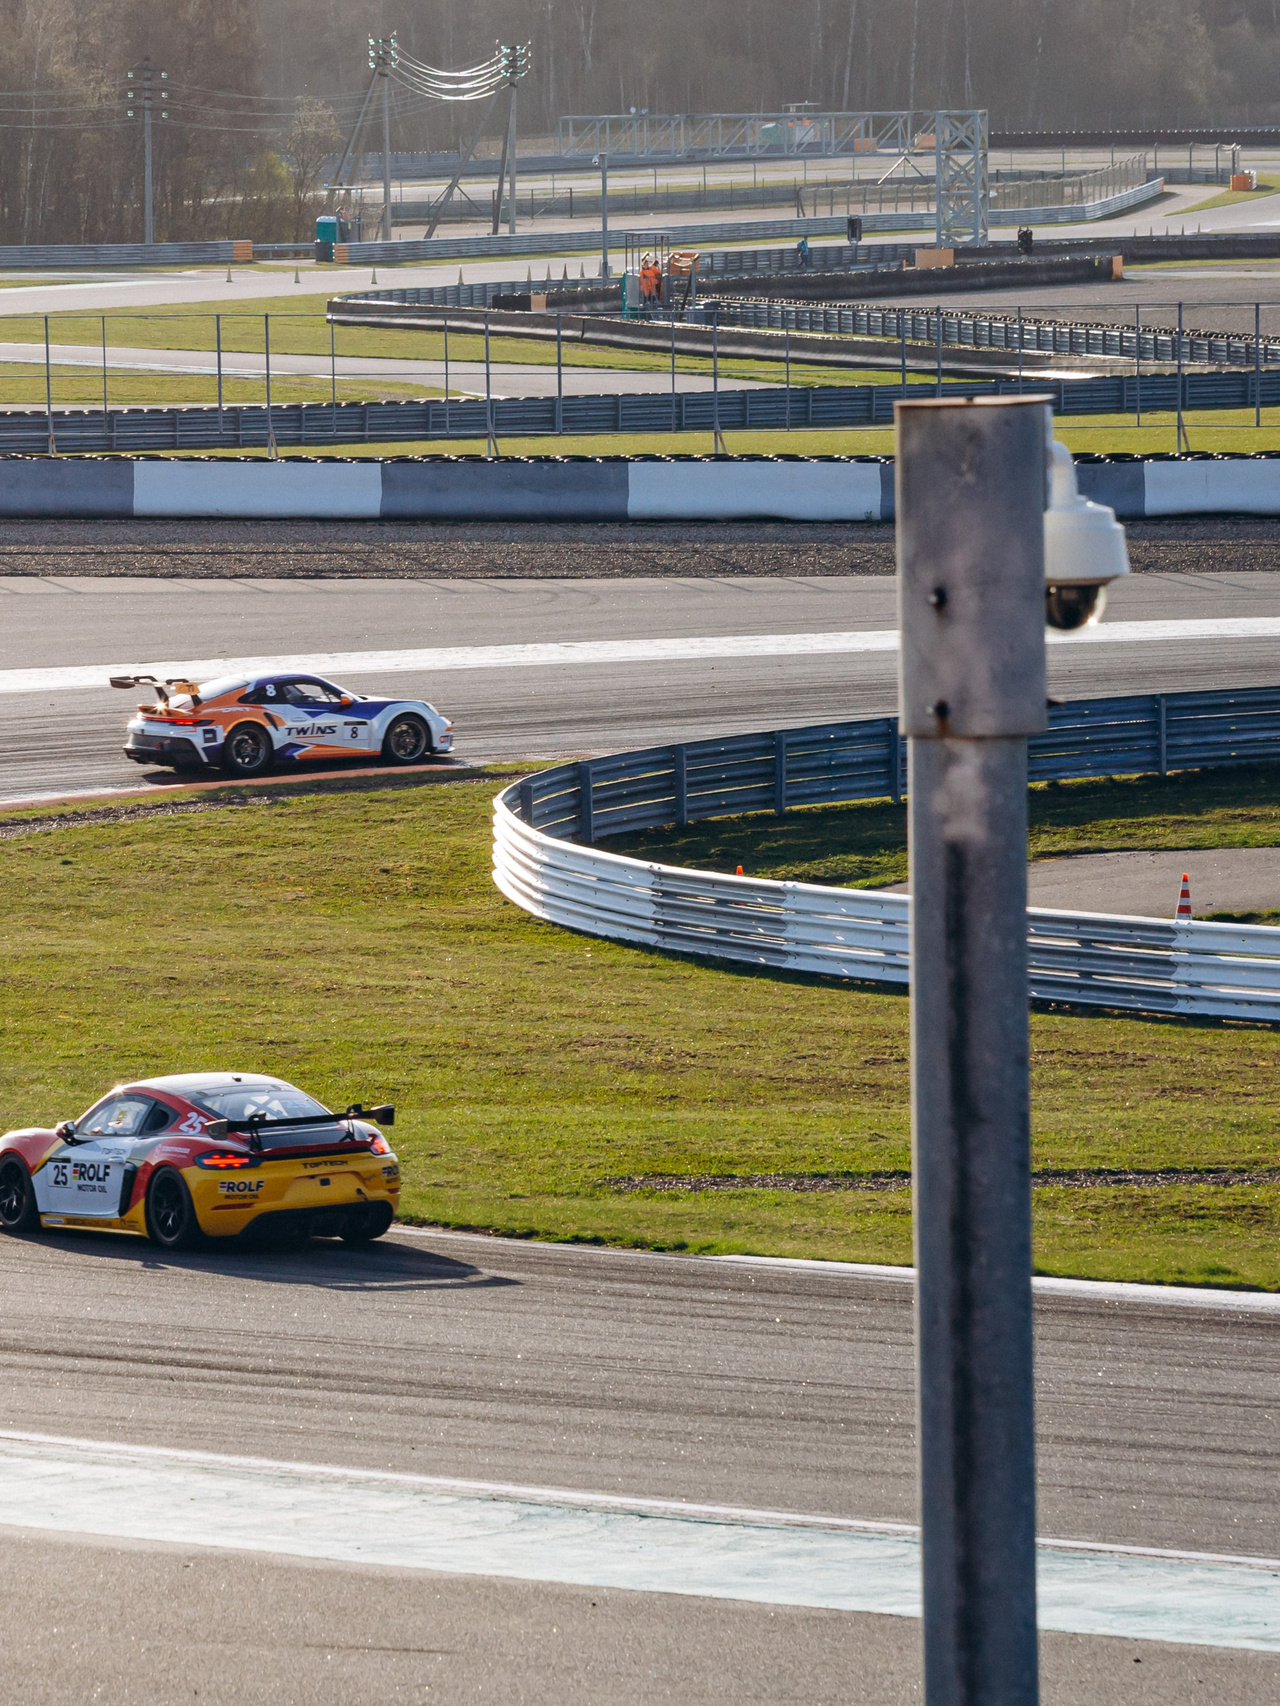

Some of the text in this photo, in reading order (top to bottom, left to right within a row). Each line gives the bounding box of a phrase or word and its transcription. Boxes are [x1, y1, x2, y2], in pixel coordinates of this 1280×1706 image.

[265, 684, 277, 697] 8
[285, 723, 338, 737] TWINS
[350, 726, 359, 739] 8
[179, 1112, 207, 1134] 25
[53, 1164, 68, 1186] 25
[77, 1163, 111, 1182] ROLF
[226, 1180, 265, 1193] ROLF
